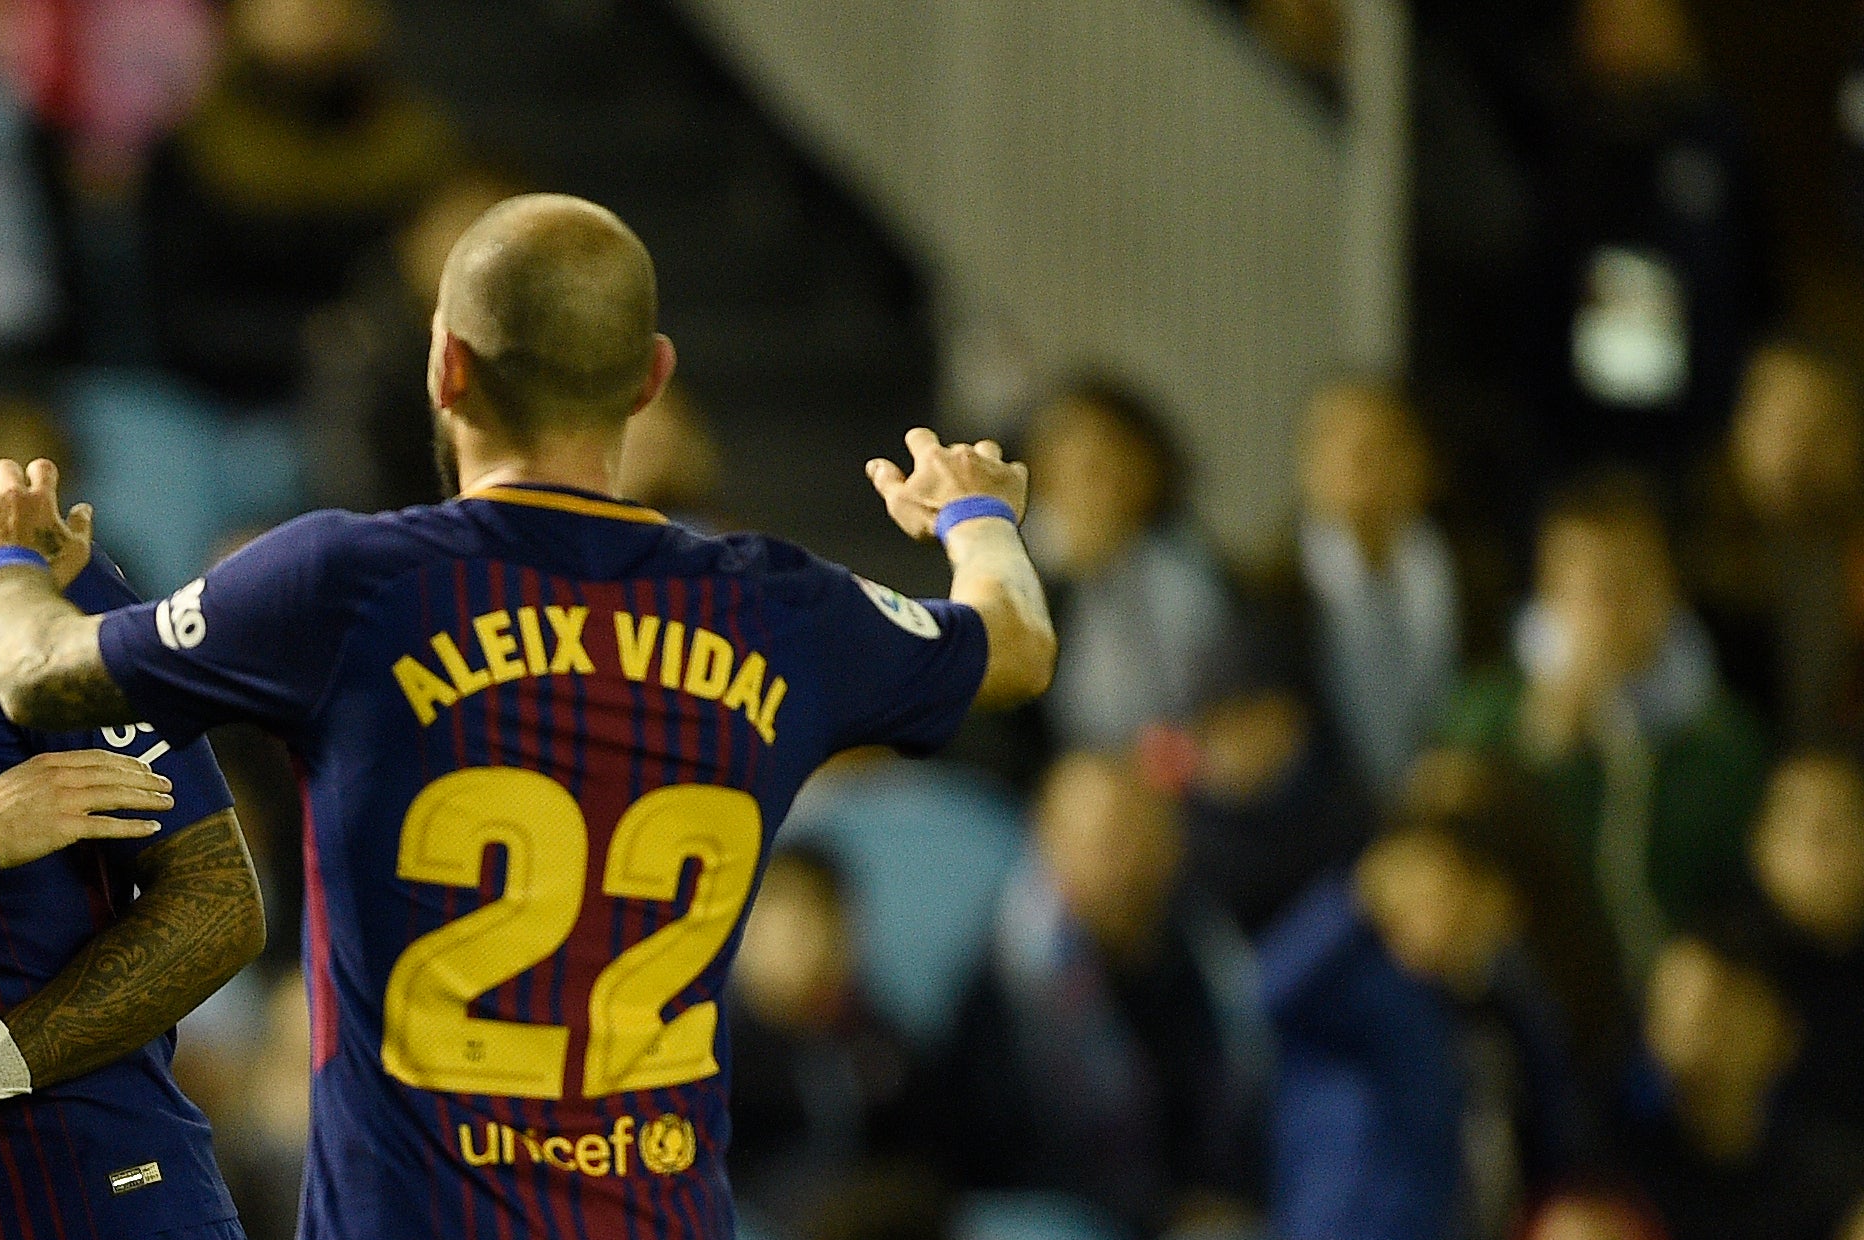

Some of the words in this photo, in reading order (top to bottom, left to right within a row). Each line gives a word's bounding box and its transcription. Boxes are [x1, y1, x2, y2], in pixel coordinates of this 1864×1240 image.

[391, 605, 596, 727] ALEIX
[612, 610, 789, 746] VIDAL
[382, 766, 763, 1101] 22
